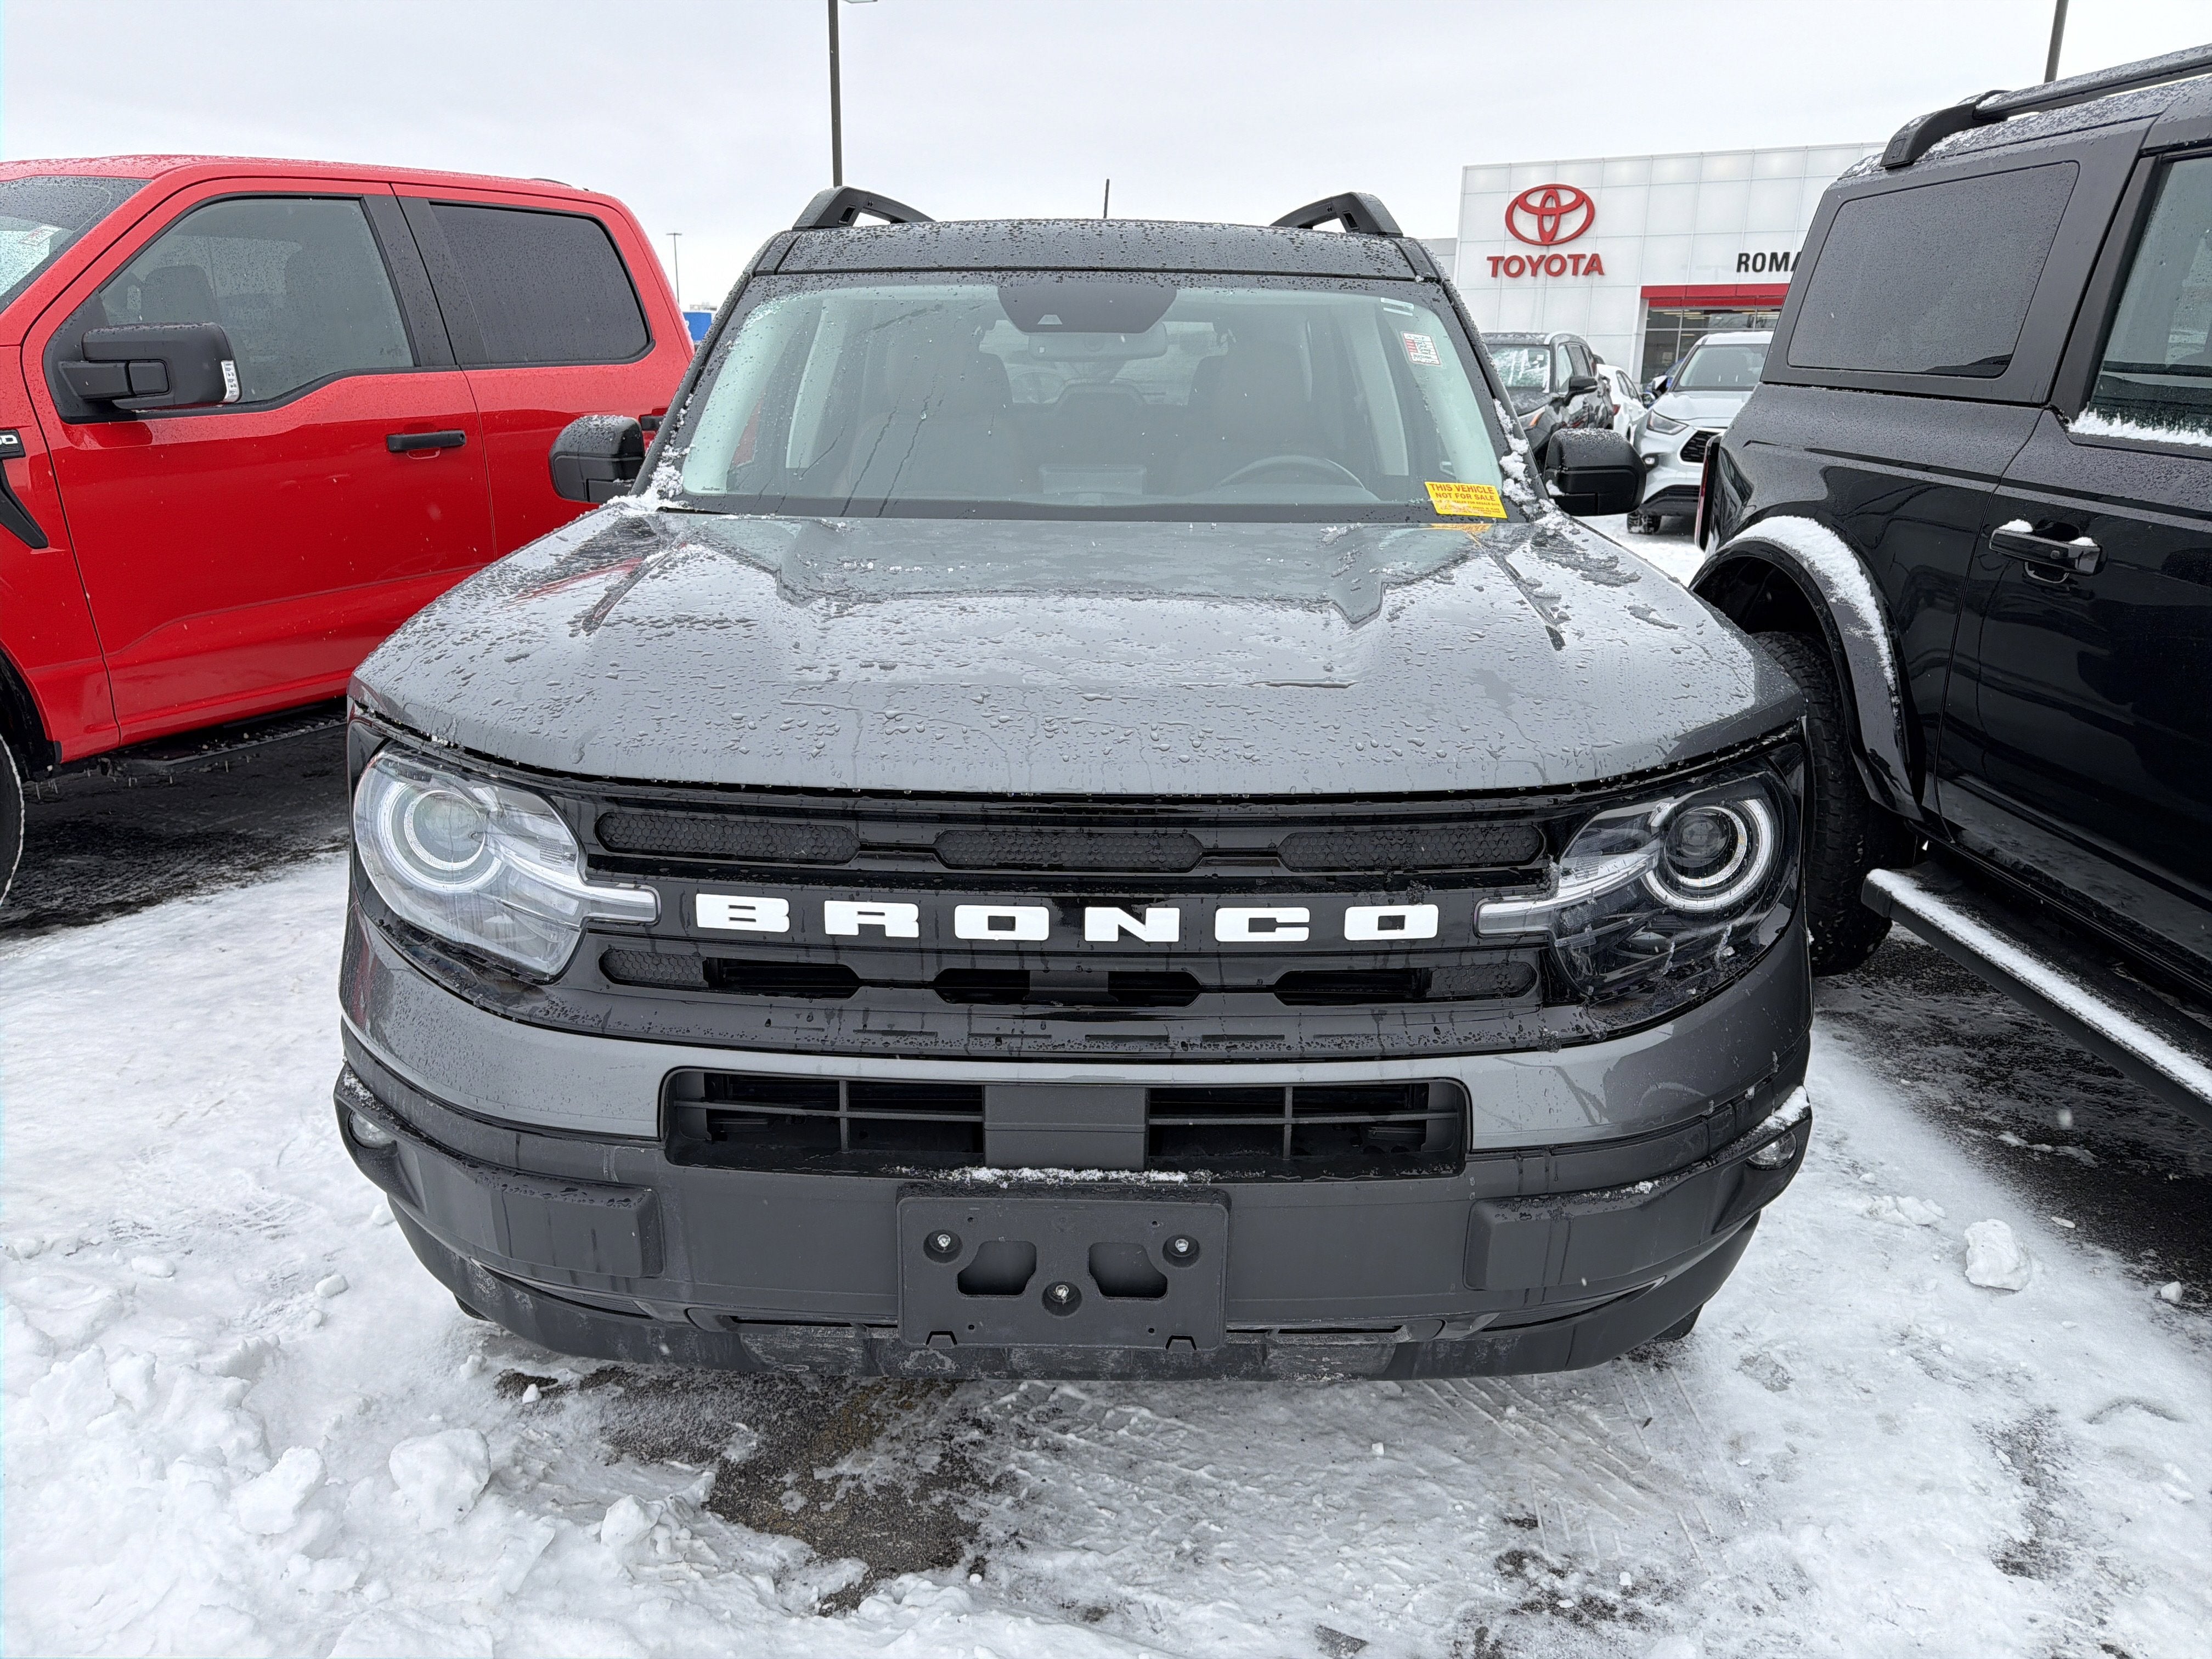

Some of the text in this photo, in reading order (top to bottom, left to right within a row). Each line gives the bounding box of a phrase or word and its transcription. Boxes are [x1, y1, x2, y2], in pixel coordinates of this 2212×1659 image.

[1487, 253, 1605, 278] TOYOTA
[1429, 483, 1494, 494] THIS VEHICLE
[696, 893, 1439, 943] BRONCO
